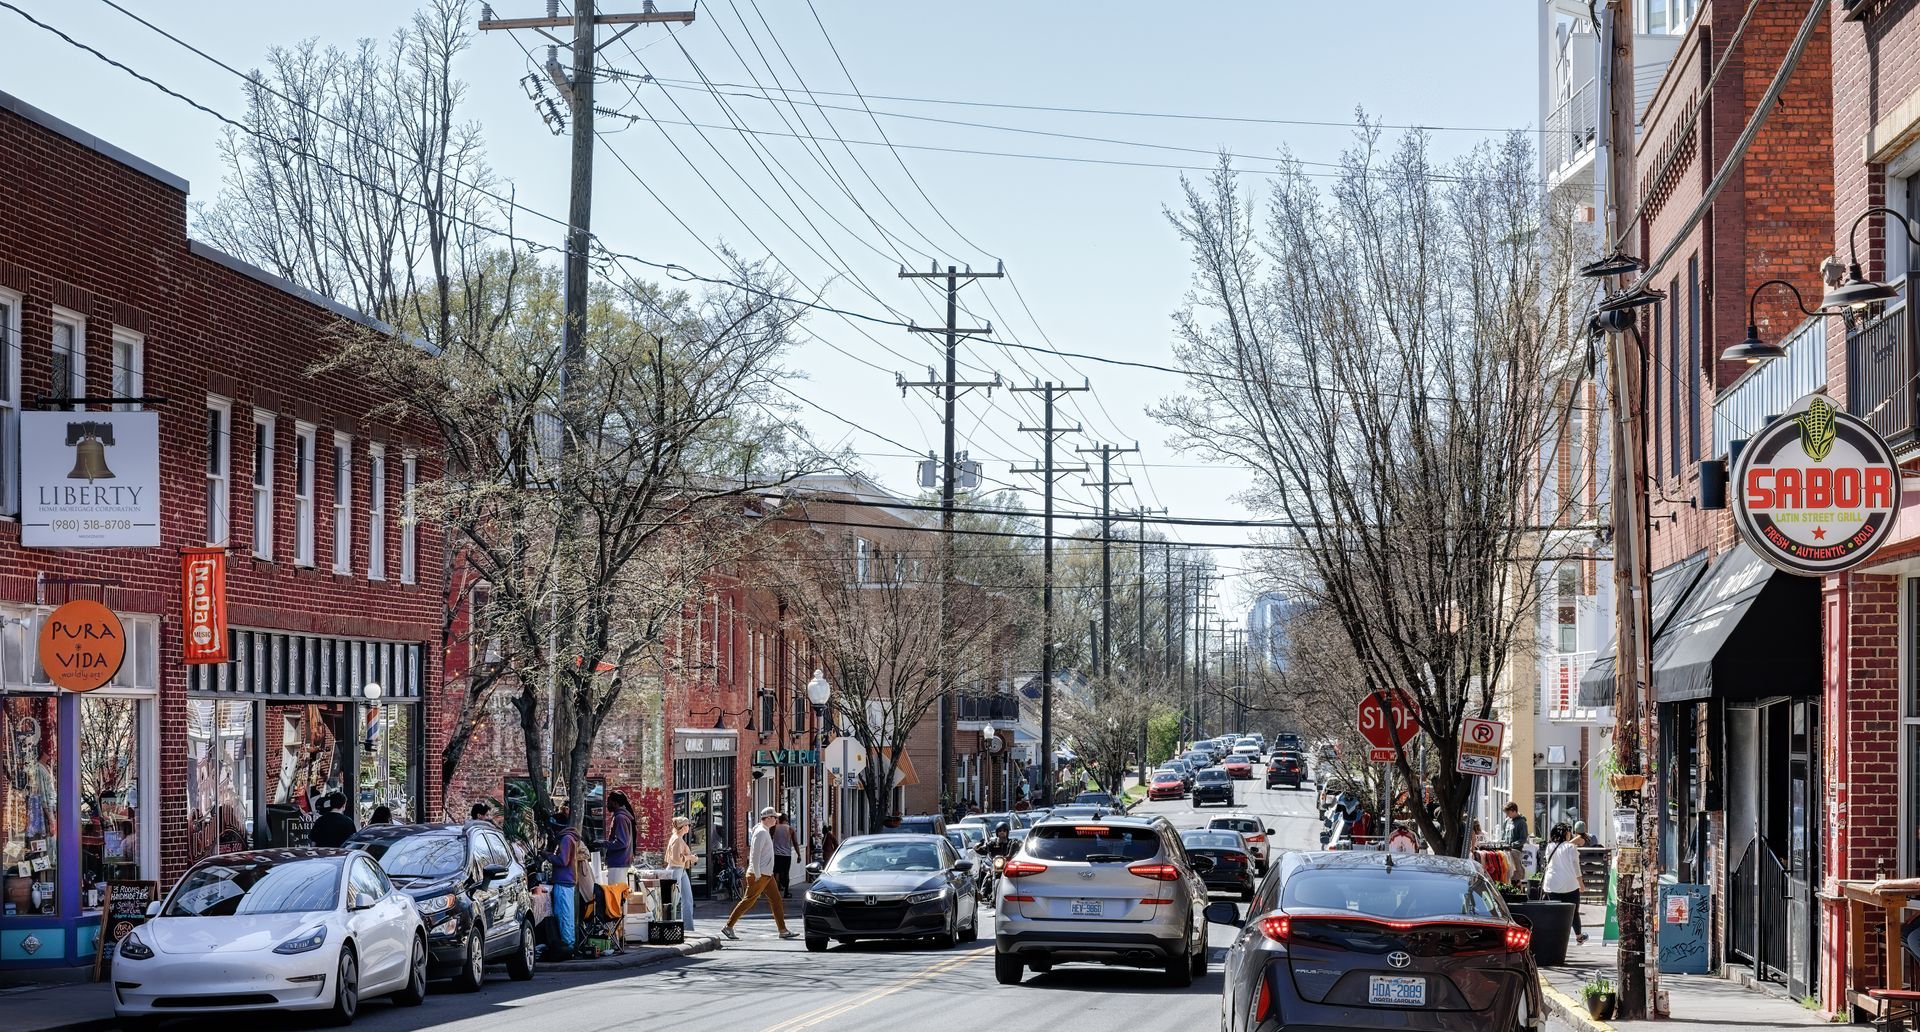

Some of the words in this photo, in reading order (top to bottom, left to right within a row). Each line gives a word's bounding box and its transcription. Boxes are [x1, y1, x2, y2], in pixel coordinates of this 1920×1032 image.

[39, 486, 143, 505] LIBERTY
[1747, 467, 1893, 509] SABOR
[1775, 512, 1800, 522] LATIN
[1801, 512, 1835, 522] STREET
[1837, 511, 1863, 522] GRILL
[52, 520, 80, 532] (980)
[83, 520, 131, 530] 318-8708
[1763, 524, 1790, 549] FRESH
[1796, 545, 1846, 559] AUTHENTIC
[1853, 524, 1875, 546] BOLD
[52, 621, 116, 640] PURA
[56, 652, 108, 668] VIDA
[1373, 752, 1387, 760] ALL
[113, 885, 119, 894] 3
[1372, 983, 1422, 998] HDA-2889
